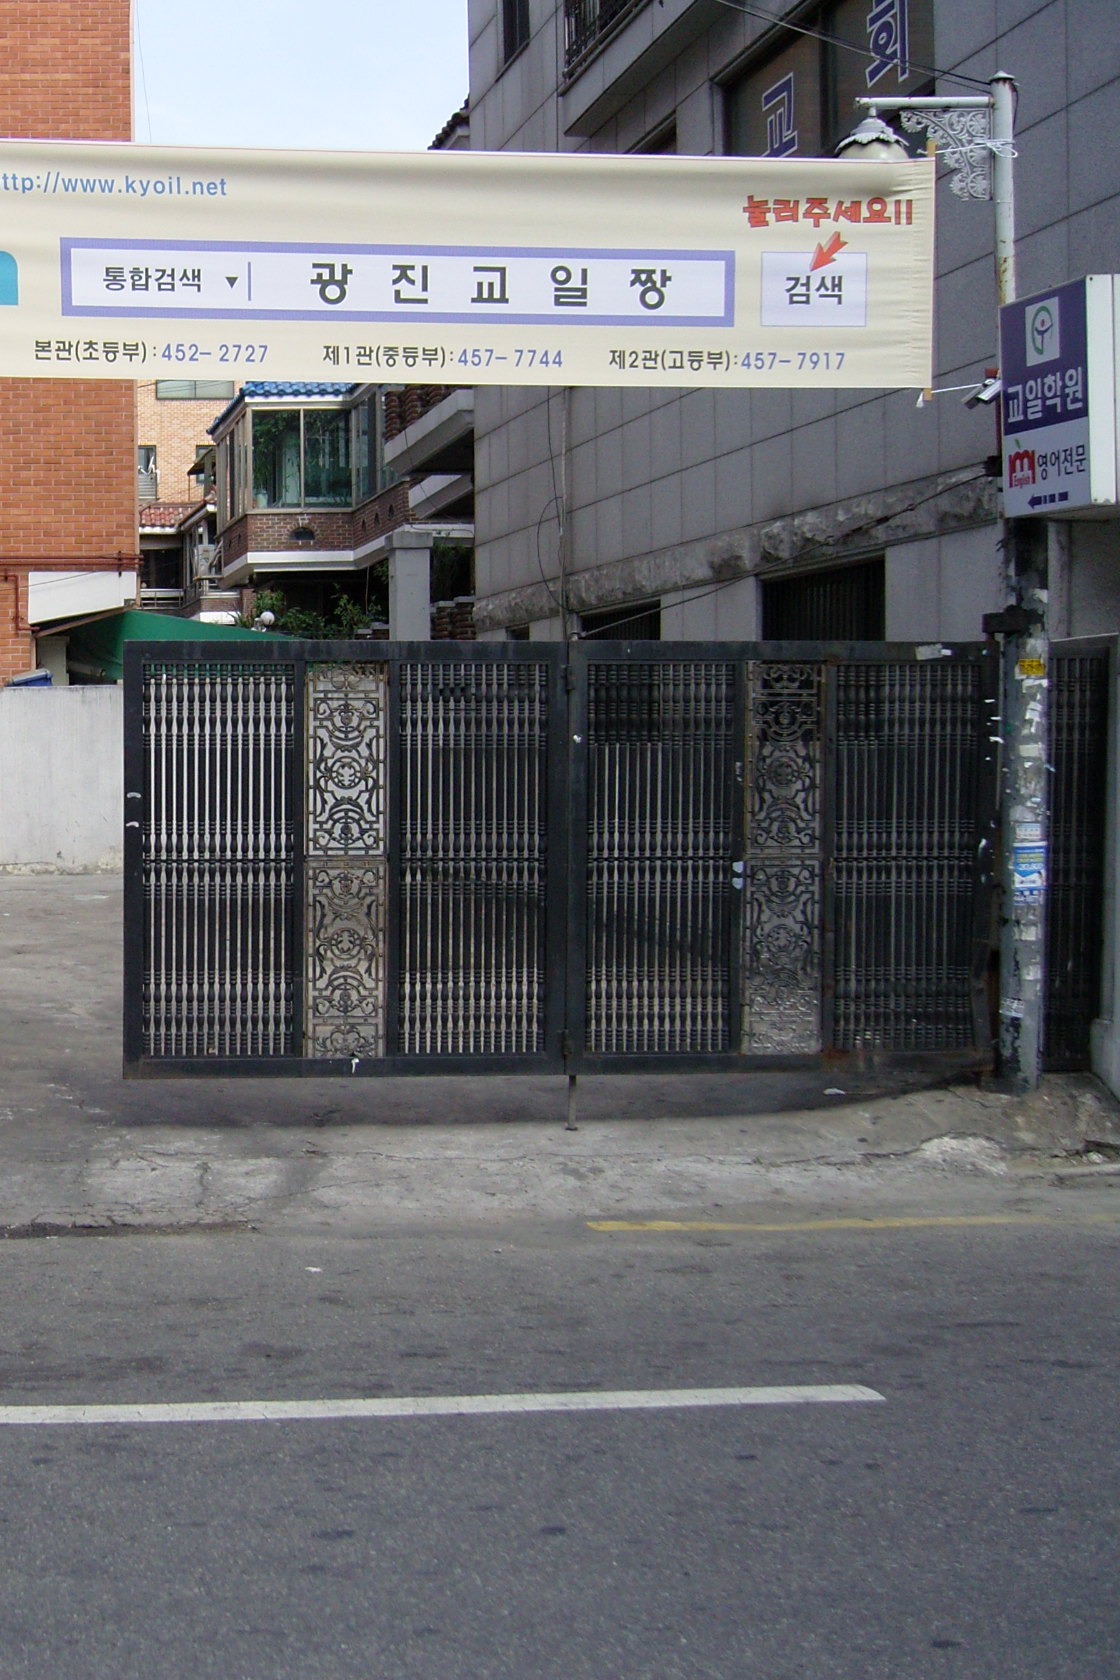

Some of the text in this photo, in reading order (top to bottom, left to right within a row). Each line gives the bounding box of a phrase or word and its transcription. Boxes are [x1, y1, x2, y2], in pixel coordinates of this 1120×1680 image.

[103, 266, 202, 293] 통합검색
[785, 275, 843, 305] 검색
[1007, 366, 1084, 424] 교일학원
[1037, 444, 1087, 481] 영어전문
